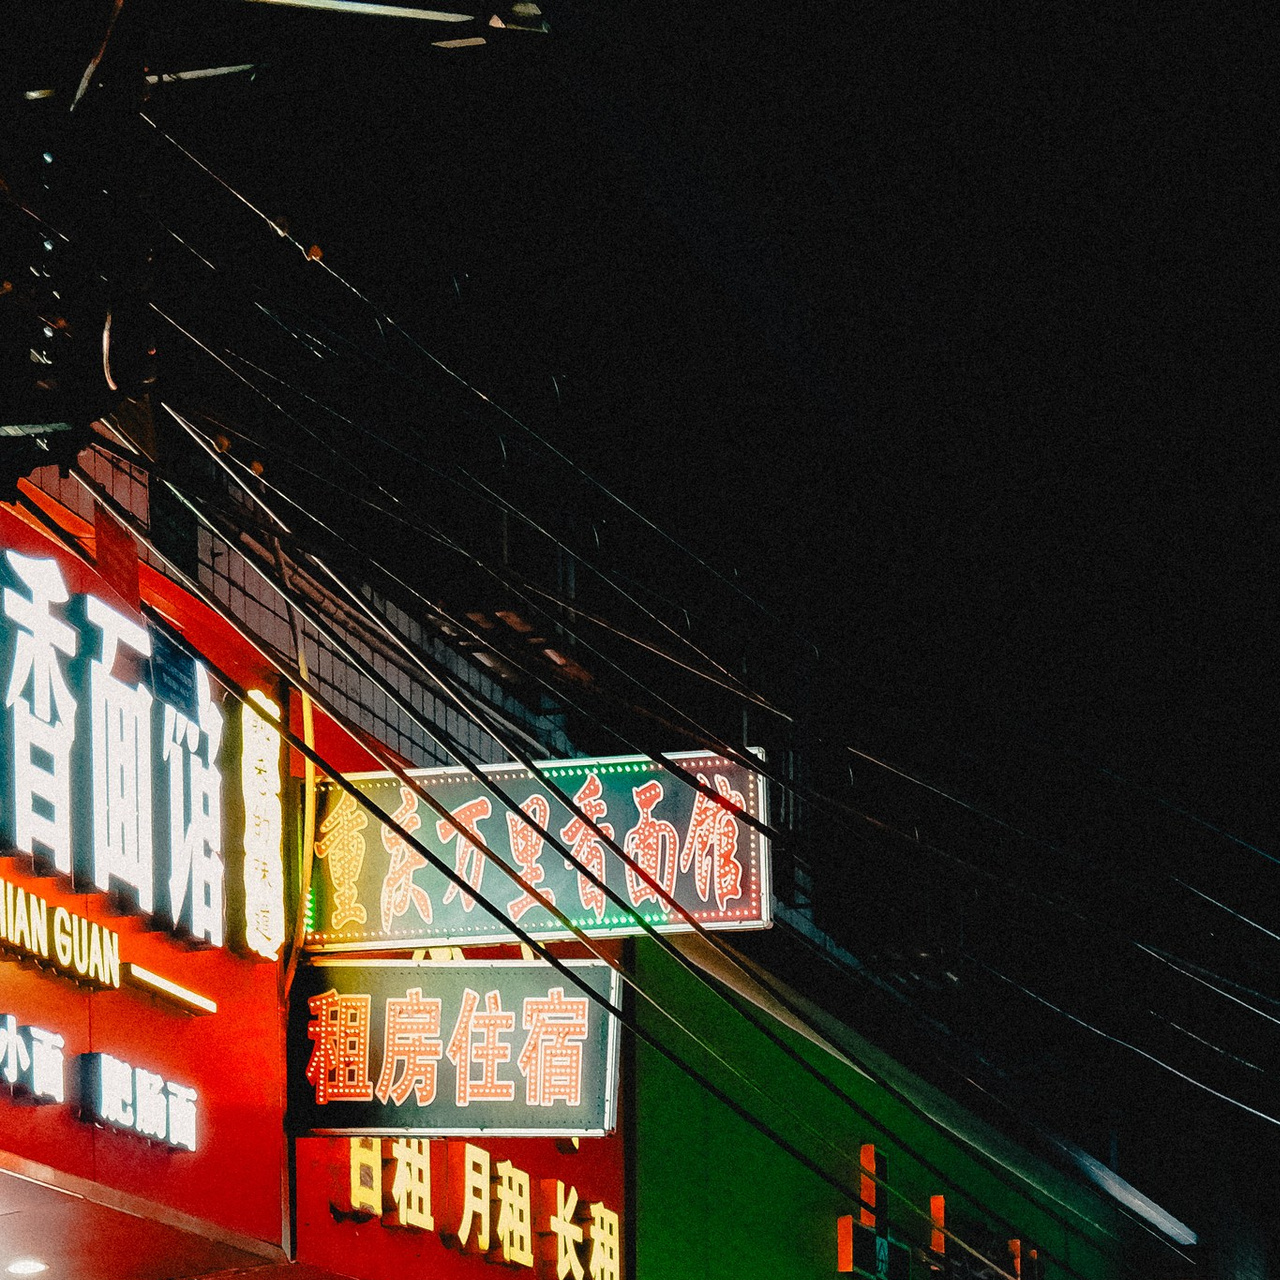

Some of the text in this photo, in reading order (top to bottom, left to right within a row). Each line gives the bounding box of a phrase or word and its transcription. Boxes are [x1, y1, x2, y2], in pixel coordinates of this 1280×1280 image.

[4, 549, 224, 948] 香面馆
[315, 772, 745, 933] 重庆万里香面馆
[54, 906, 120, 989] GUAN
[307, 987, 589, 1107] 租房住宿
[458, 1142, 534, 1267] 月租
